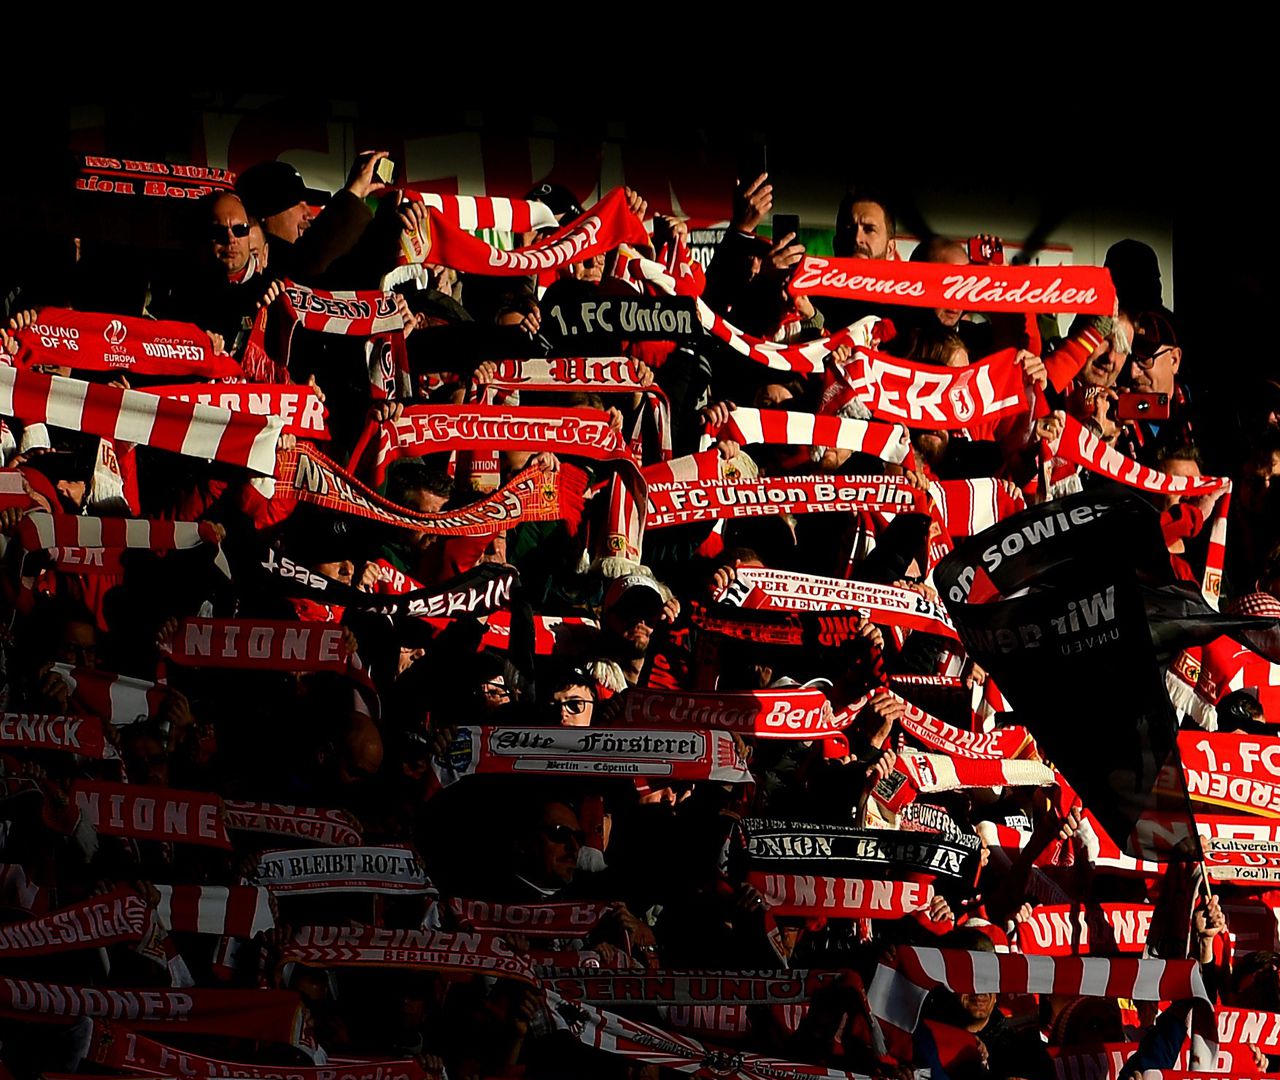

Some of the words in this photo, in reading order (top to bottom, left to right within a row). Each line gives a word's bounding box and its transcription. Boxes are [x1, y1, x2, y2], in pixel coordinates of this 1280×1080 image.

[793, 256, 926, 298] Eisernes
[942, 271, 1100, 306] Mädchen
[550, 307, 580, 338] 1.
[582, 303, 612, 334] FC
[620, 302, 692, 333] Union
[30, 324, 80, 340] ROUND
[40, 336, 60, 350] OF
[62, 338, 79, 350] 16
[103, 355, 136, 367] EUROPA
[698, 474, 771, 490] UNIONER
[786, 474, 837, 486] IMMER
[671, 486, 709, 508] FC
[715, 484, 801, 506] Union
[811, 482, 913, 506] Berlin
[646, 506, 719, 526] JETZT
[734, 504, 789, 519] ERST
[806, 501, 885, 515] RECHT
[408, 576, 515, 618] BERLIN
[800, 586, 911, 609] AUFGEBEN
[624, 695, 664, 724] FC
[670, 696, 758, 725] Union
[497, 731, 556, 753] Alte
[576, 726, 698, 756] Försterei
[1197, 741, 1231, 772] 1.
[265, 815, 330, 838] NACH
[1211, 840, 1279, 852] Kultverein
[290, 855, 355, 878] BLEIBT
[1233, 867, 1263, 879] You'll
[382, 951, 450, 962] BERLIN
[458, 952, 488, 965] IST
[5, 982, 194, 1020] UNIONER
